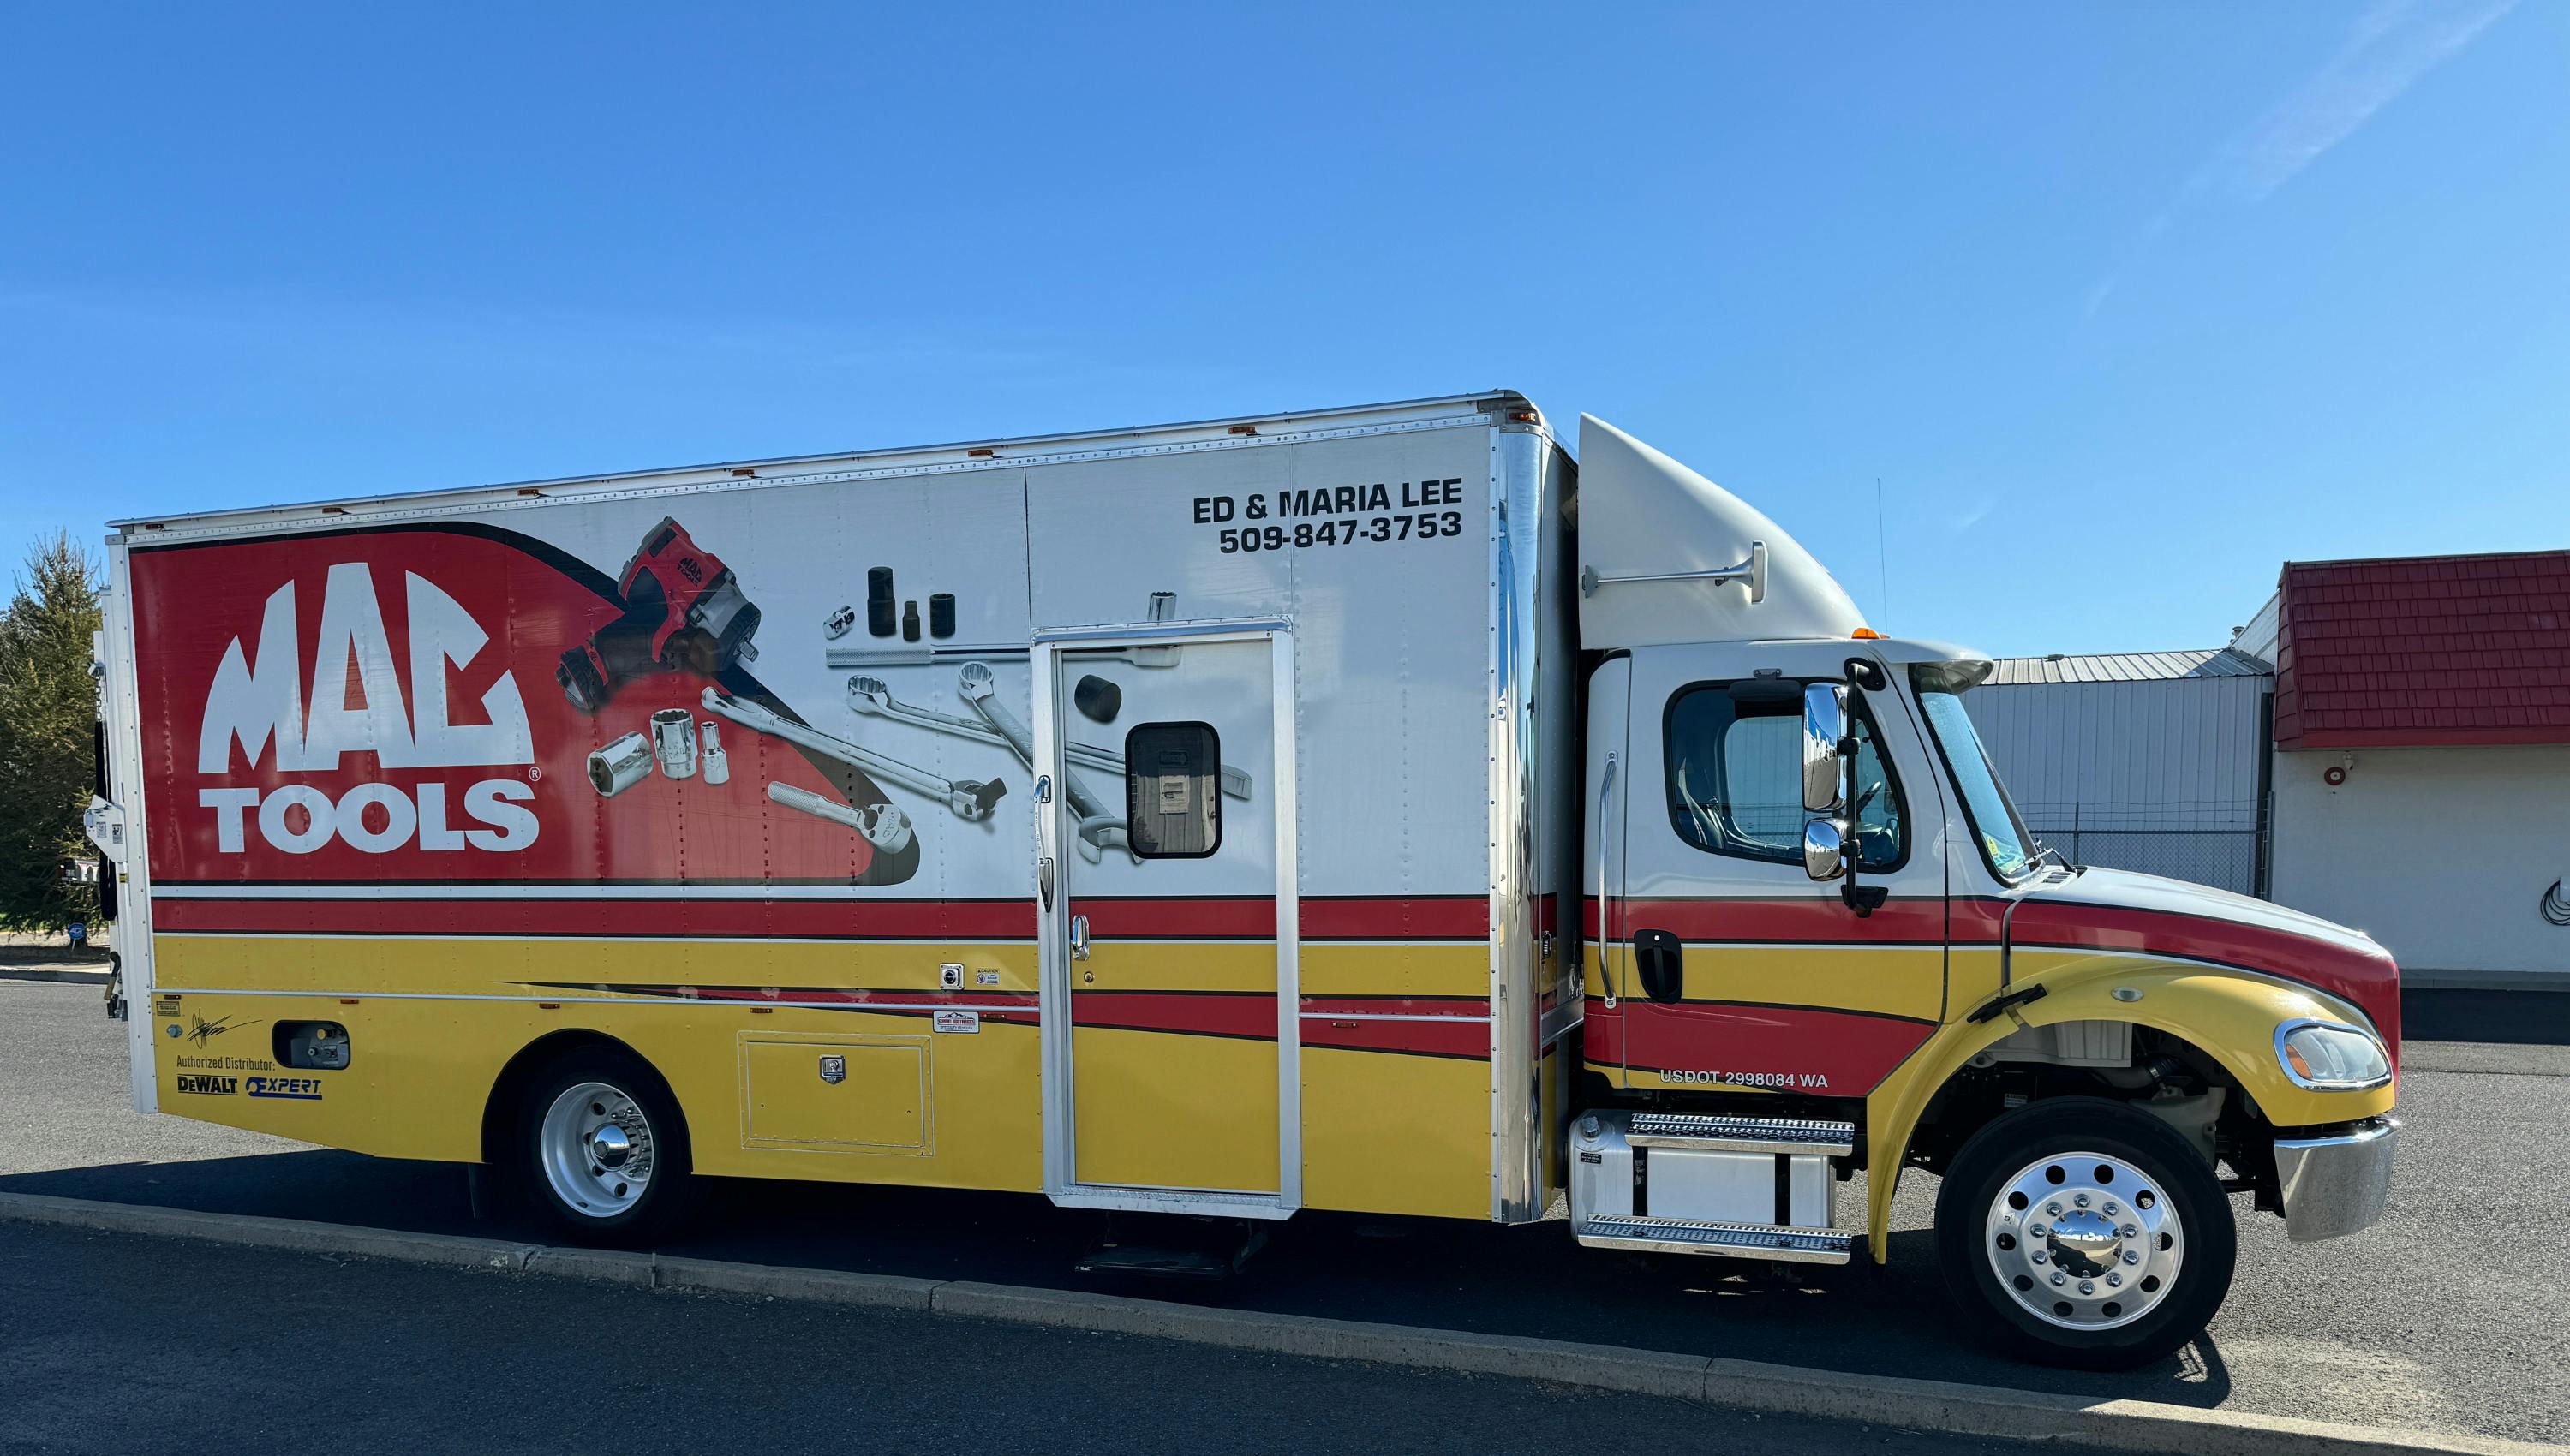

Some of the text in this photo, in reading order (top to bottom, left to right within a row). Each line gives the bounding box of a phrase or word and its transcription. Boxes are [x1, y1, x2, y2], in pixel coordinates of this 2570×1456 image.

[1193, 478, 1462, 524] ED & MARIA LEE
[1220, 511, 1461, 554] 509-847-3753
[198, 562, 535, 774] MAC
[199, 779, 540, 854] TOOLS
[176, 1054, 276, 1071] Authorized Distributor:
[1659, 1069, 1829, 1088] USDOT 2998084 WA
